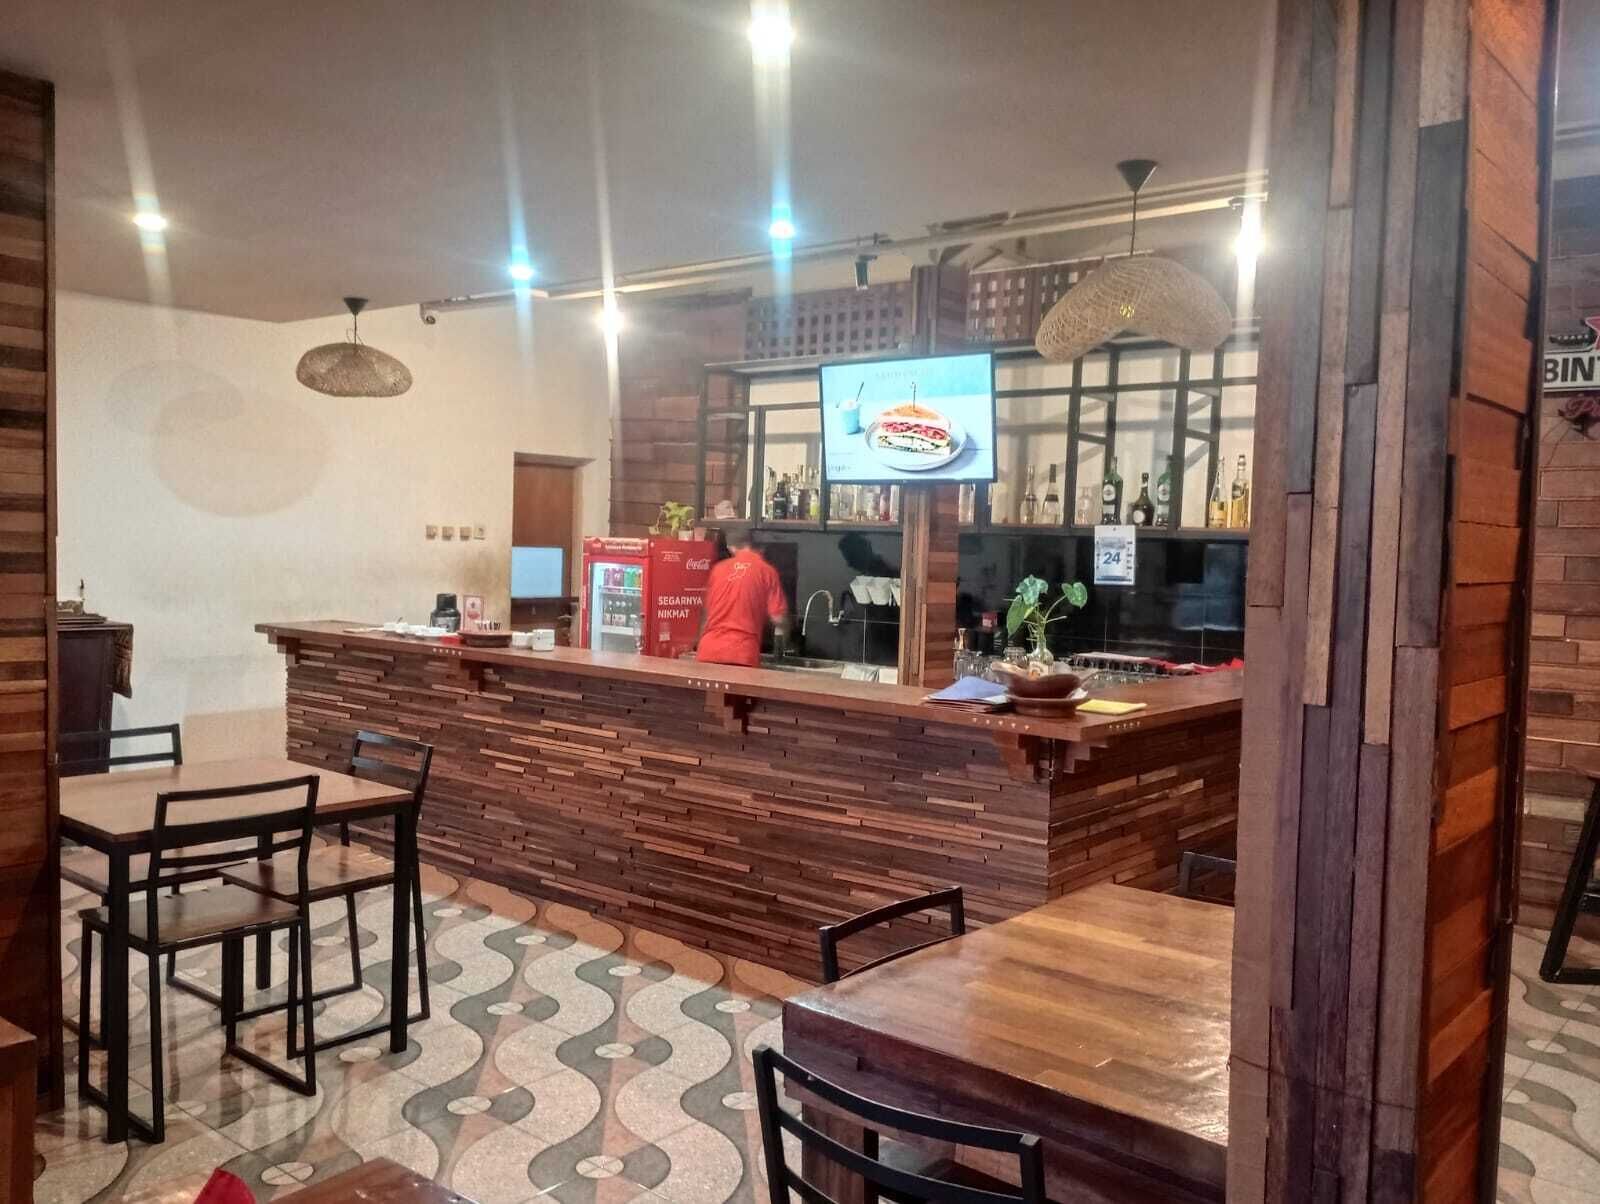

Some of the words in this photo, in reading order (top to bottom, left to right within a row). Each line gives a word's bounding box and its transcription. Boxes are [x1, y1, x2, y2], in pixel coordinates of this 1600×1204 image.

[1544, 356, 1600, 383] BIN
[1103, 551, 1121, 565] 24
[658, 595, 703, 606] SEGARNYA
[657, 609, 689, 618] NIKMAT
